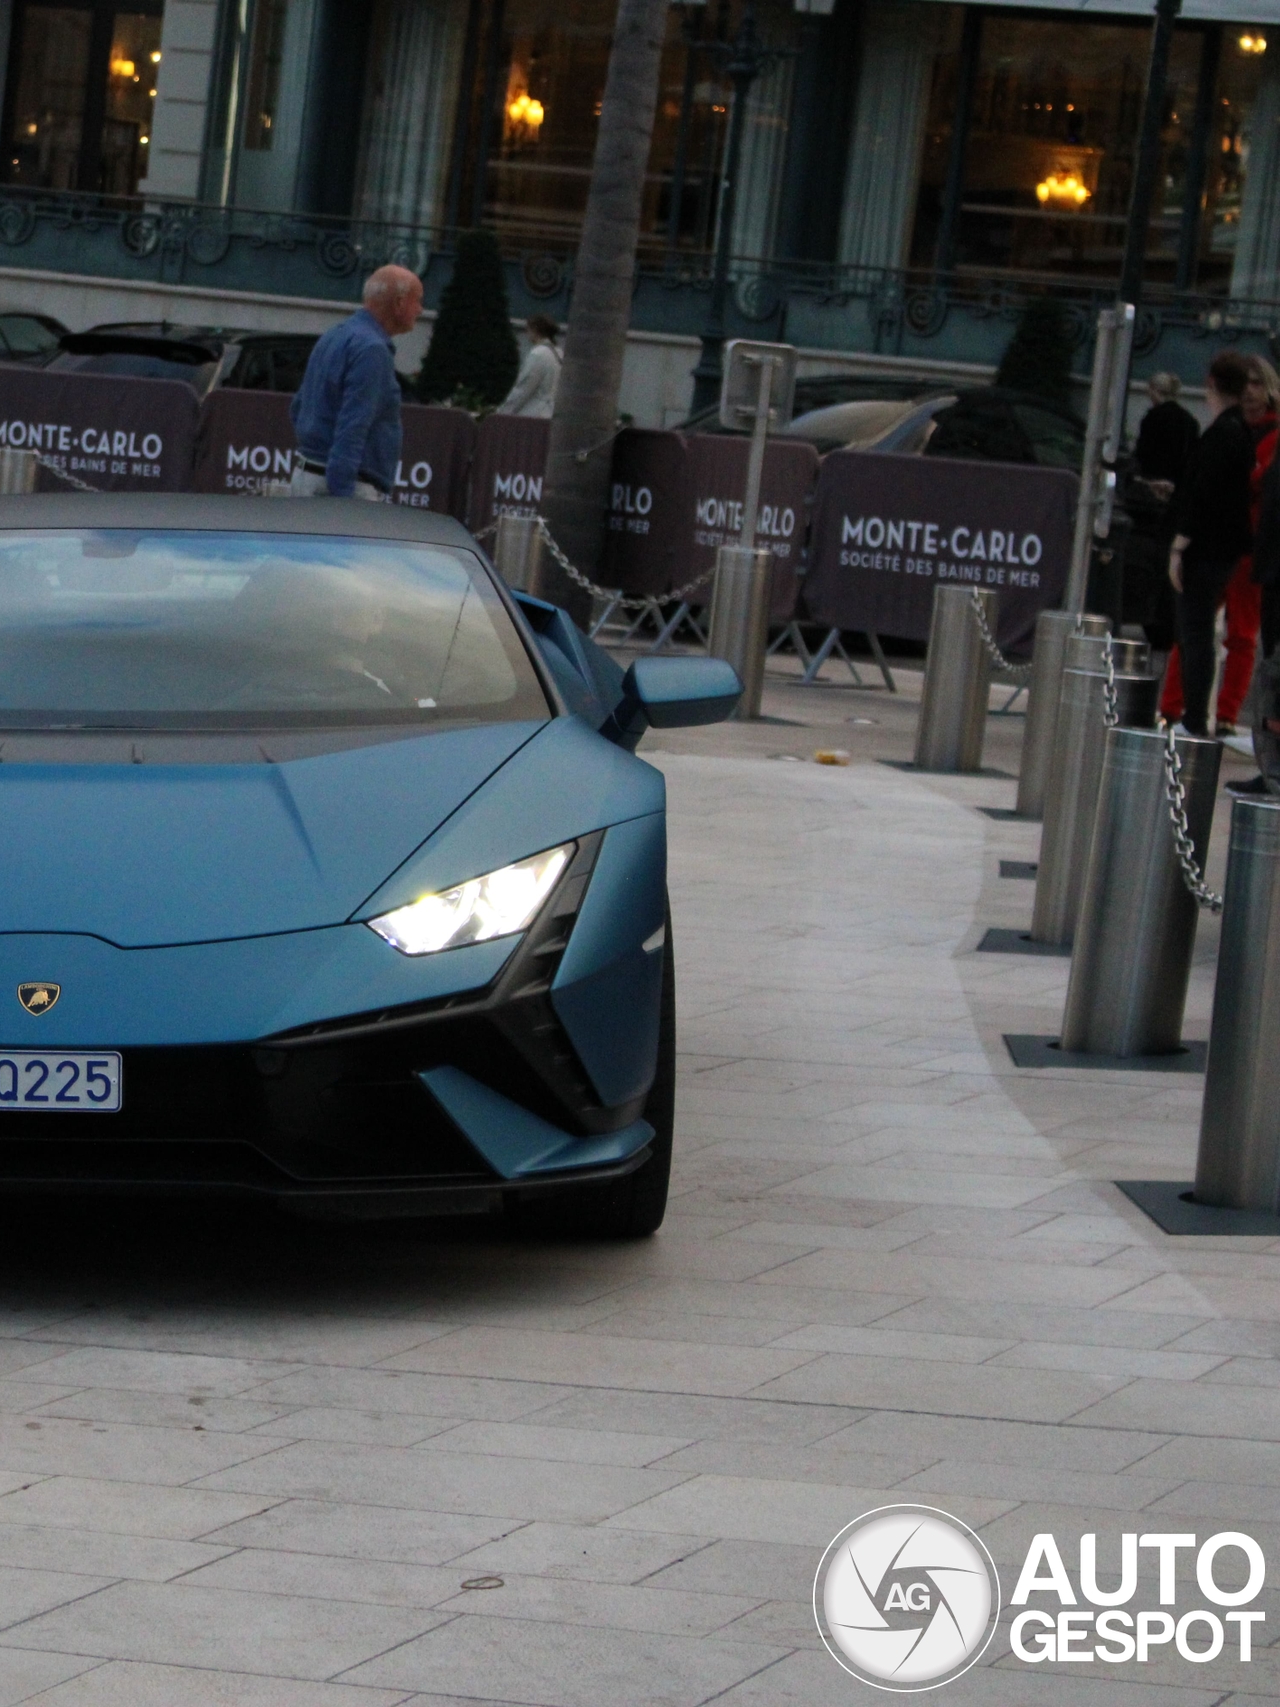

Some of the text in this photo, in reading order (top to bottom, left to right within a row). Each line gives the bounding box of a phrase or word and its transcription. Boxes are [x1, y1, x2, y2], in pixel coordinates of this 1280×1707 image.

[70, 456, 106, 473] BAINS
[111, 460, 126, 475] DE
[132, 463, 161, 478] MER
[399, 493, 429, 507] MER
[905, 558, 933, 576] DES
[938, 561, 981, 582] BAINS
[986, 568, 1005, 585] DE
[1010, 570, 1040, 588] MER
